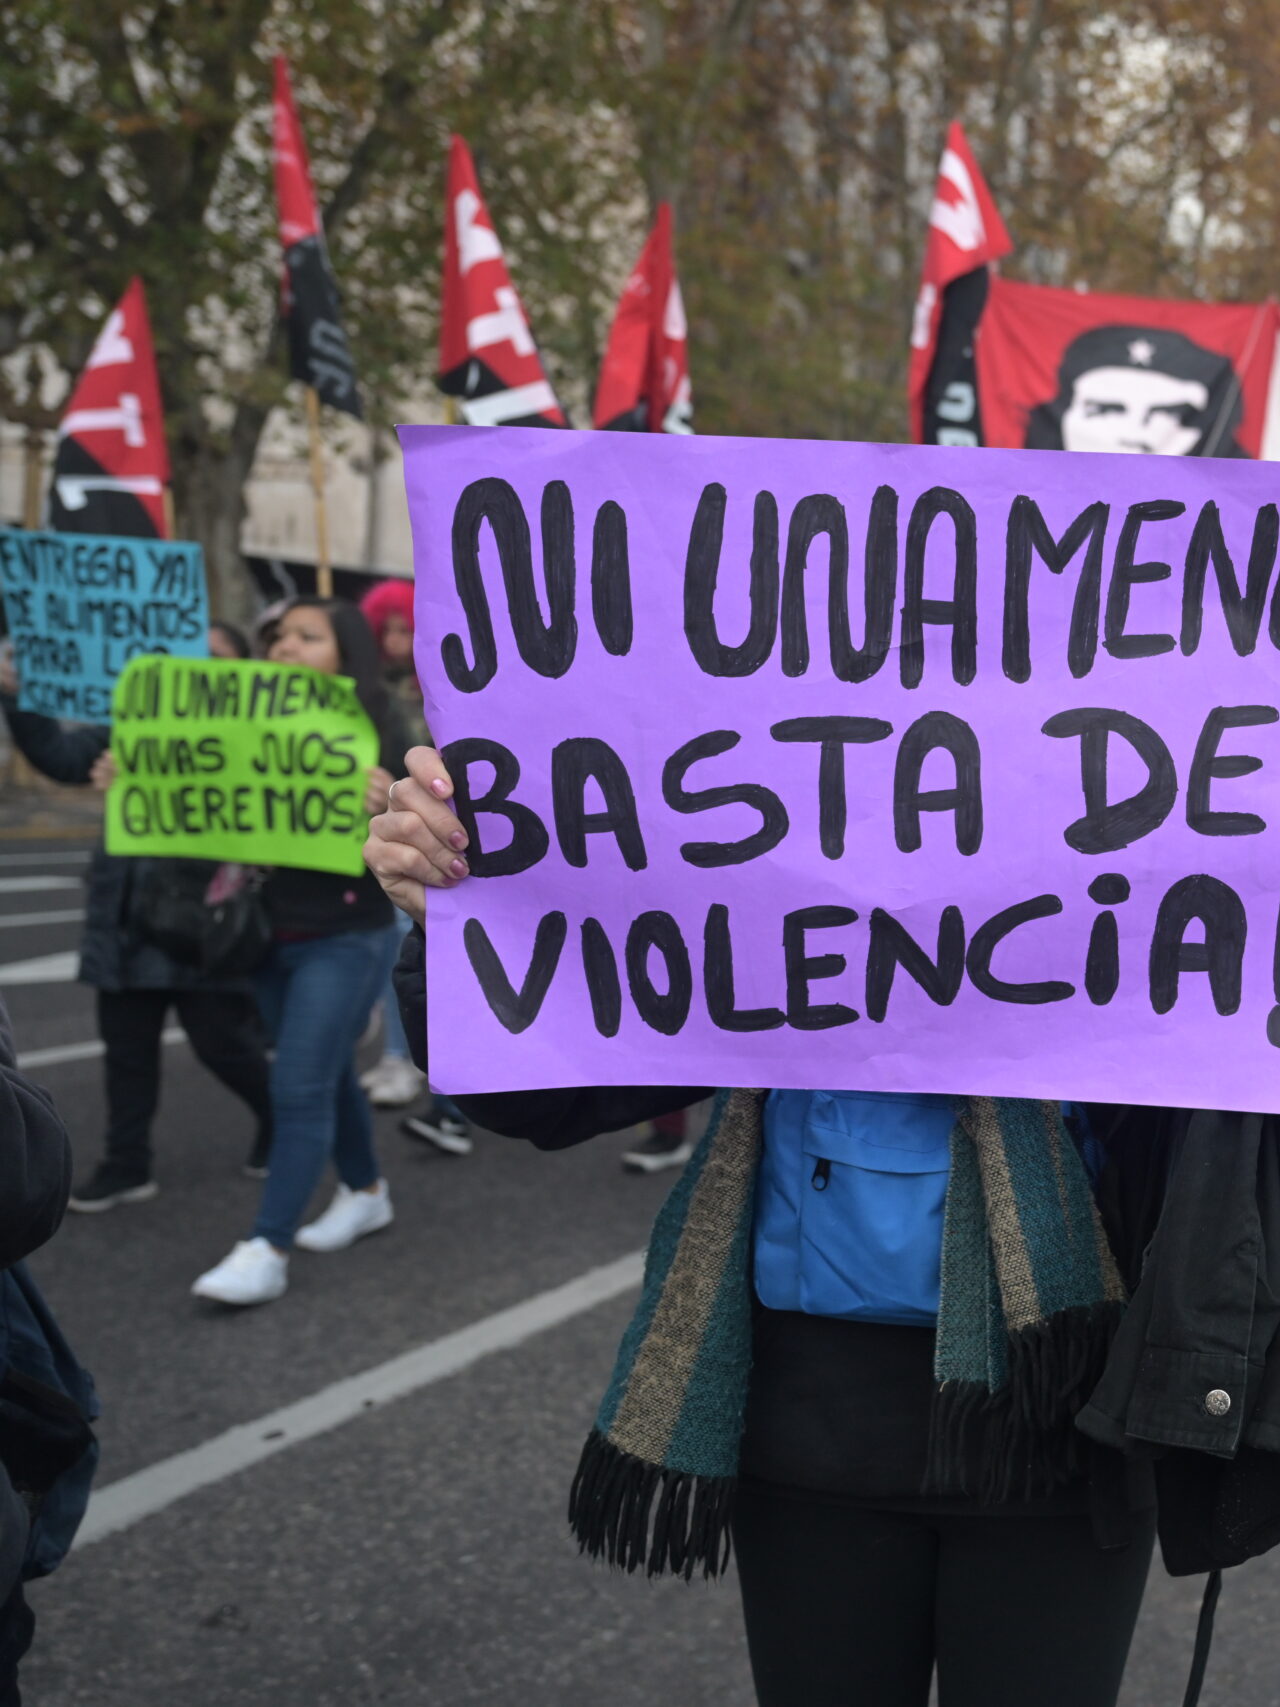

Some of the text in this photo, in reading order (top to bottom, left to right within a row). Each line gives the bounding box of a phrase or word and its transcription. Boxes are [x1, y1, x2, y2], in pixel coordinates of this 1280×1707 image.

[442, 477, 633, 692] NI
[684, 484, 978, 688] UNA
[171, 668, 240, 721] UNA
[117, 736, 227, 777] VIVAS
[442, 705, 1280, 878] BASTA DE
